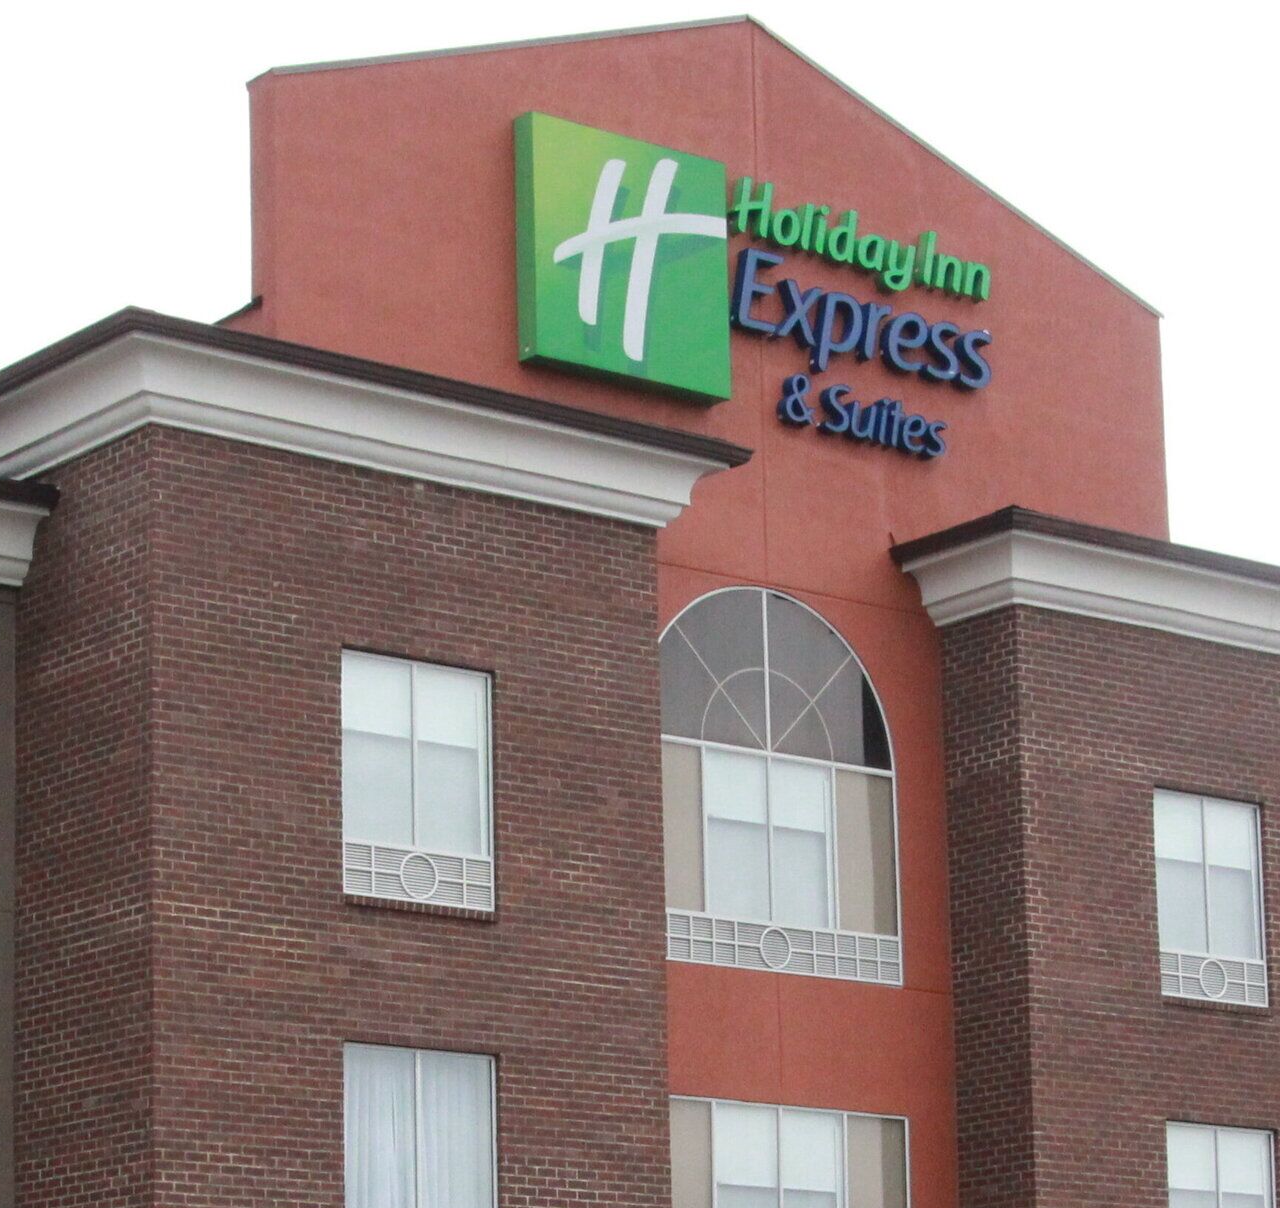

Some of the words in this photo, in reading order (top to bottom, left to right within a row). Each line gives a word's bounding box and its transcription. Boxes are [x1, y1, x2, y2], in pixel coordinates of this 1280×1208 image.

[728, 175, 916, 291] Holiday
[918, 230, 991, 301] Inn
[731, 247, 992, 390] Express
[778, 373, 816, 424] &
[818, 384, 949, 457] Suites
